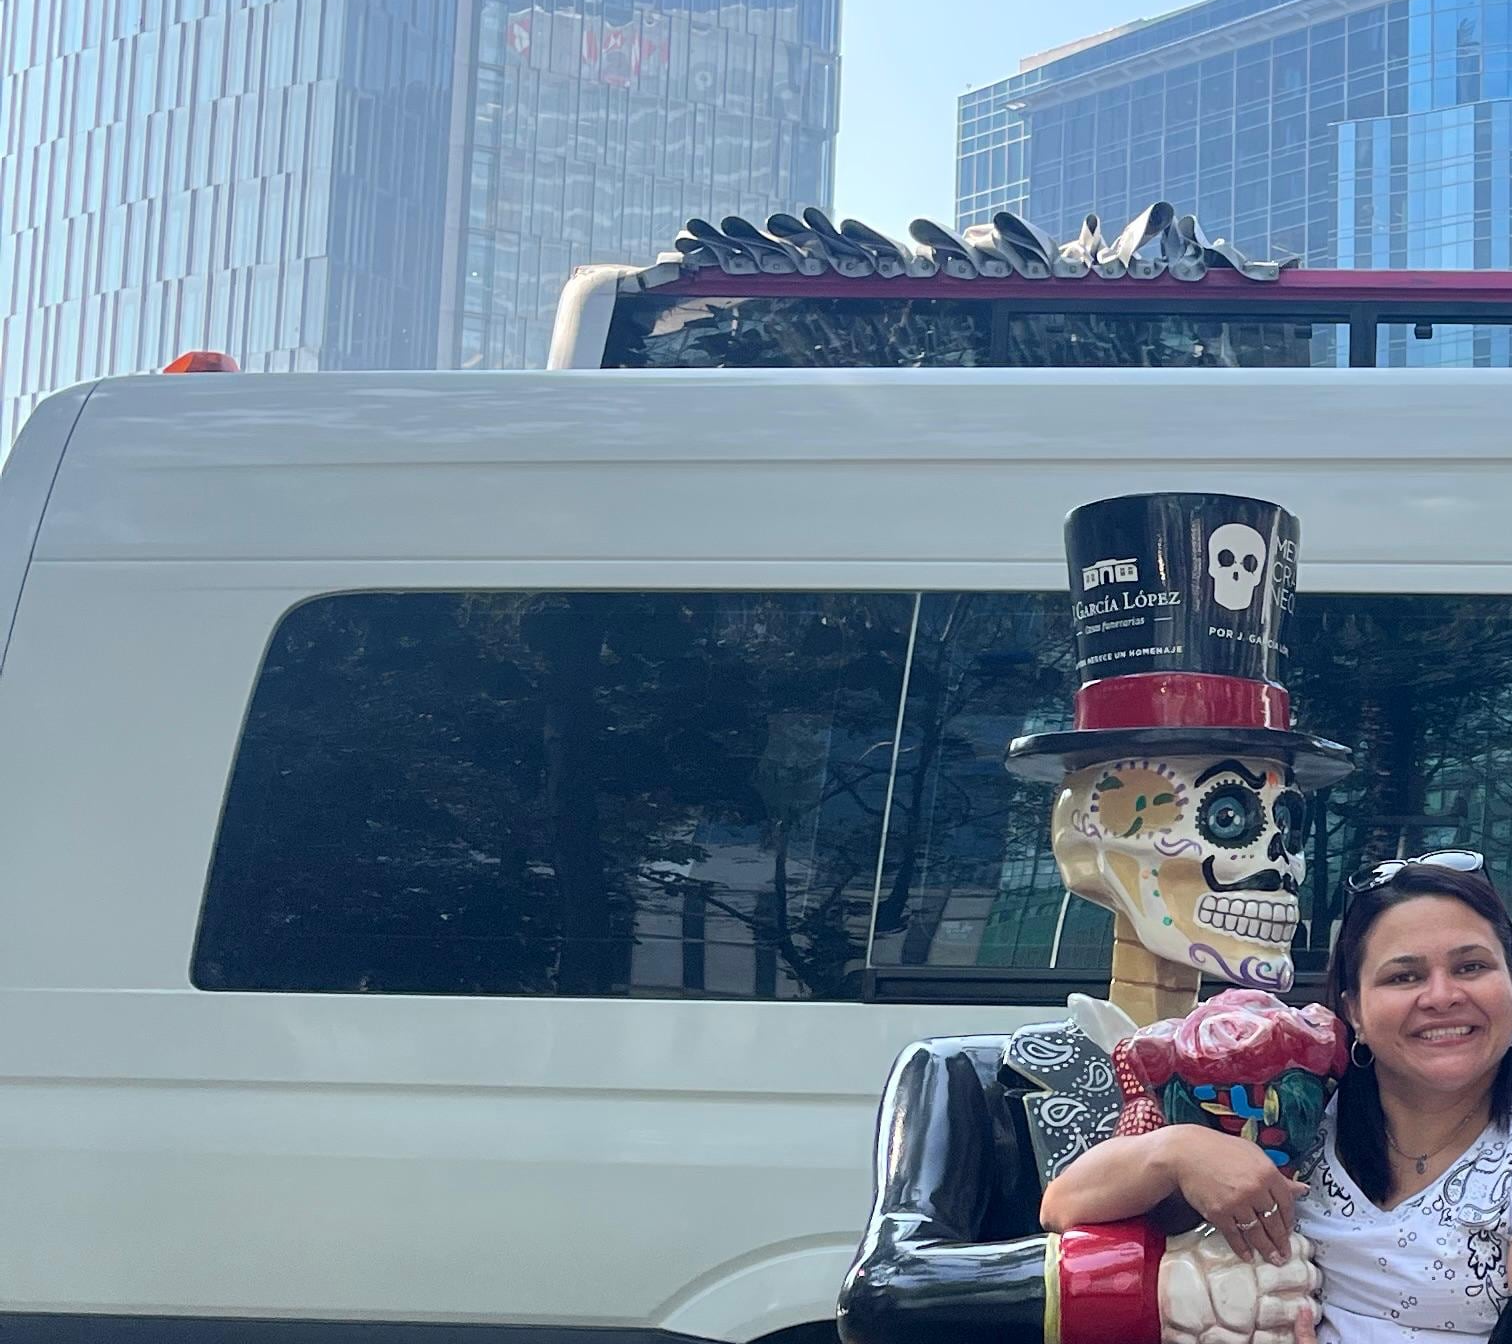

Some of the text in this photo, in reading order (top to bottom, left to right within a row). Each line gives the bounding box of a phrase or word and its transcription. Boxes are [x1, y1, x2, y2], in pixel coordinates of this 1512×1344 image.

[1076, 594, 1119, 620] GARCÍA
[1122, 589, 1181, 610] LÓPEZ
[1208, 626, 1234, 639] POR
[1114, 650, 1126, 660] UN
[1128, 645, 1183, 657] HOMENAJE
